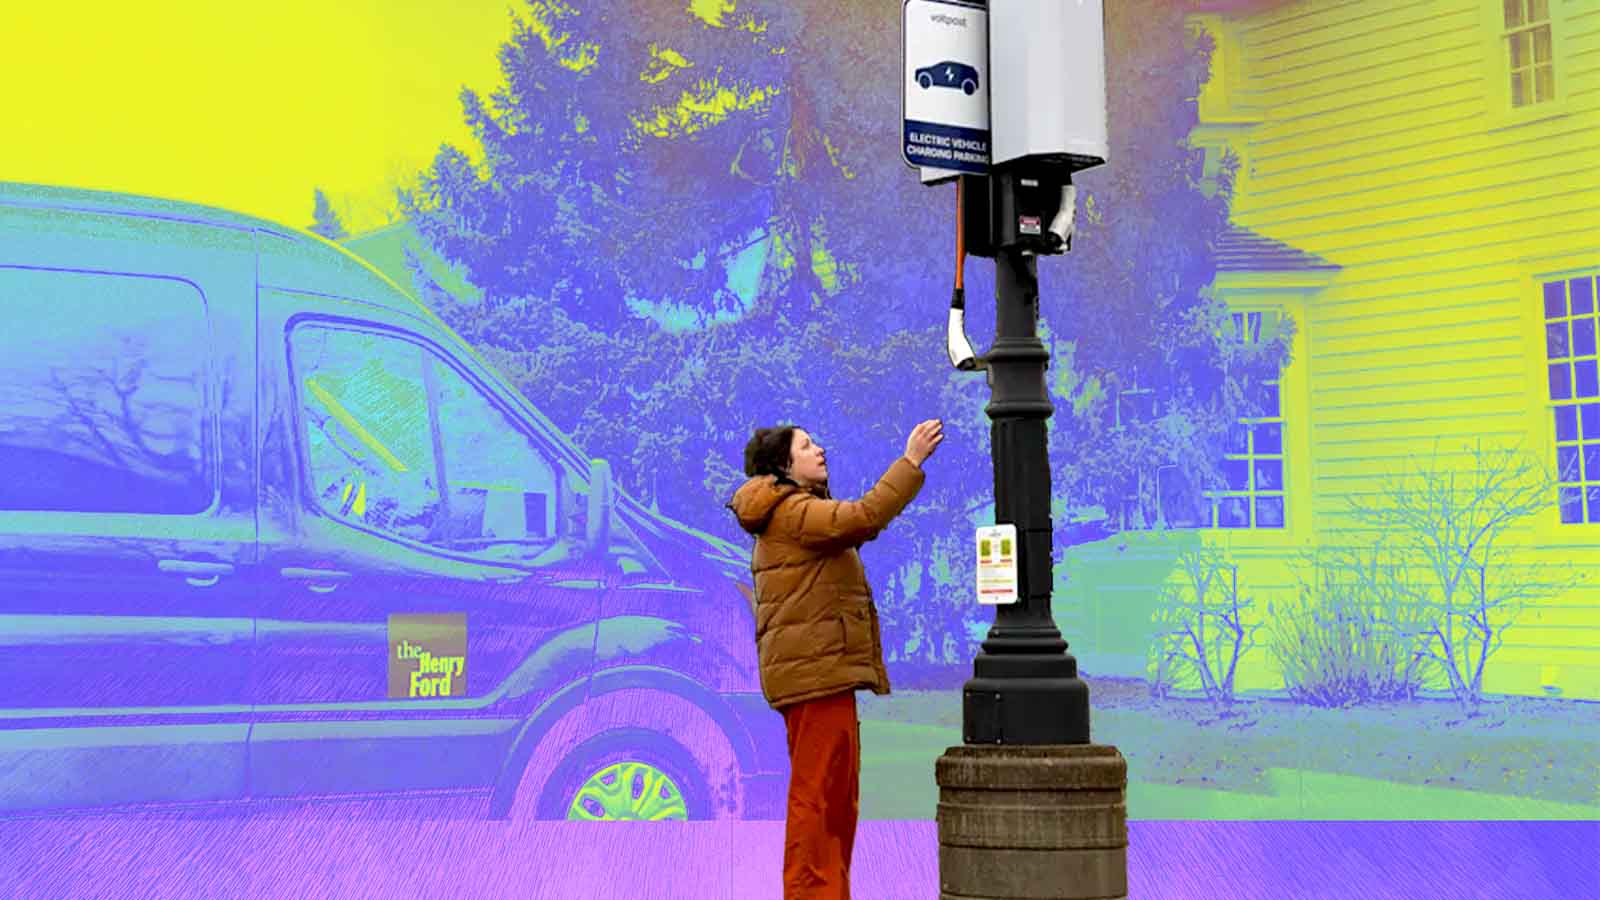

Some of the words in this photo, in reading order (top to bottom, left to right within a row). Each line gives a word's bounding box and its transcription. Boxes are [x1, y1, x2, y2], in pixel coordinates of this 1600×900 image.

[930, 14, 967, 27] voltpost
[910, 132, 951, 146] ELECTRIC
[952, 137, 987, 152] VEHICLE
[906, 145, 953, 160] CHARGING
[397, 640, 422, 659] the
[419, 652, 465, 676] Henry
[409, 671, 451, 697] Ford
